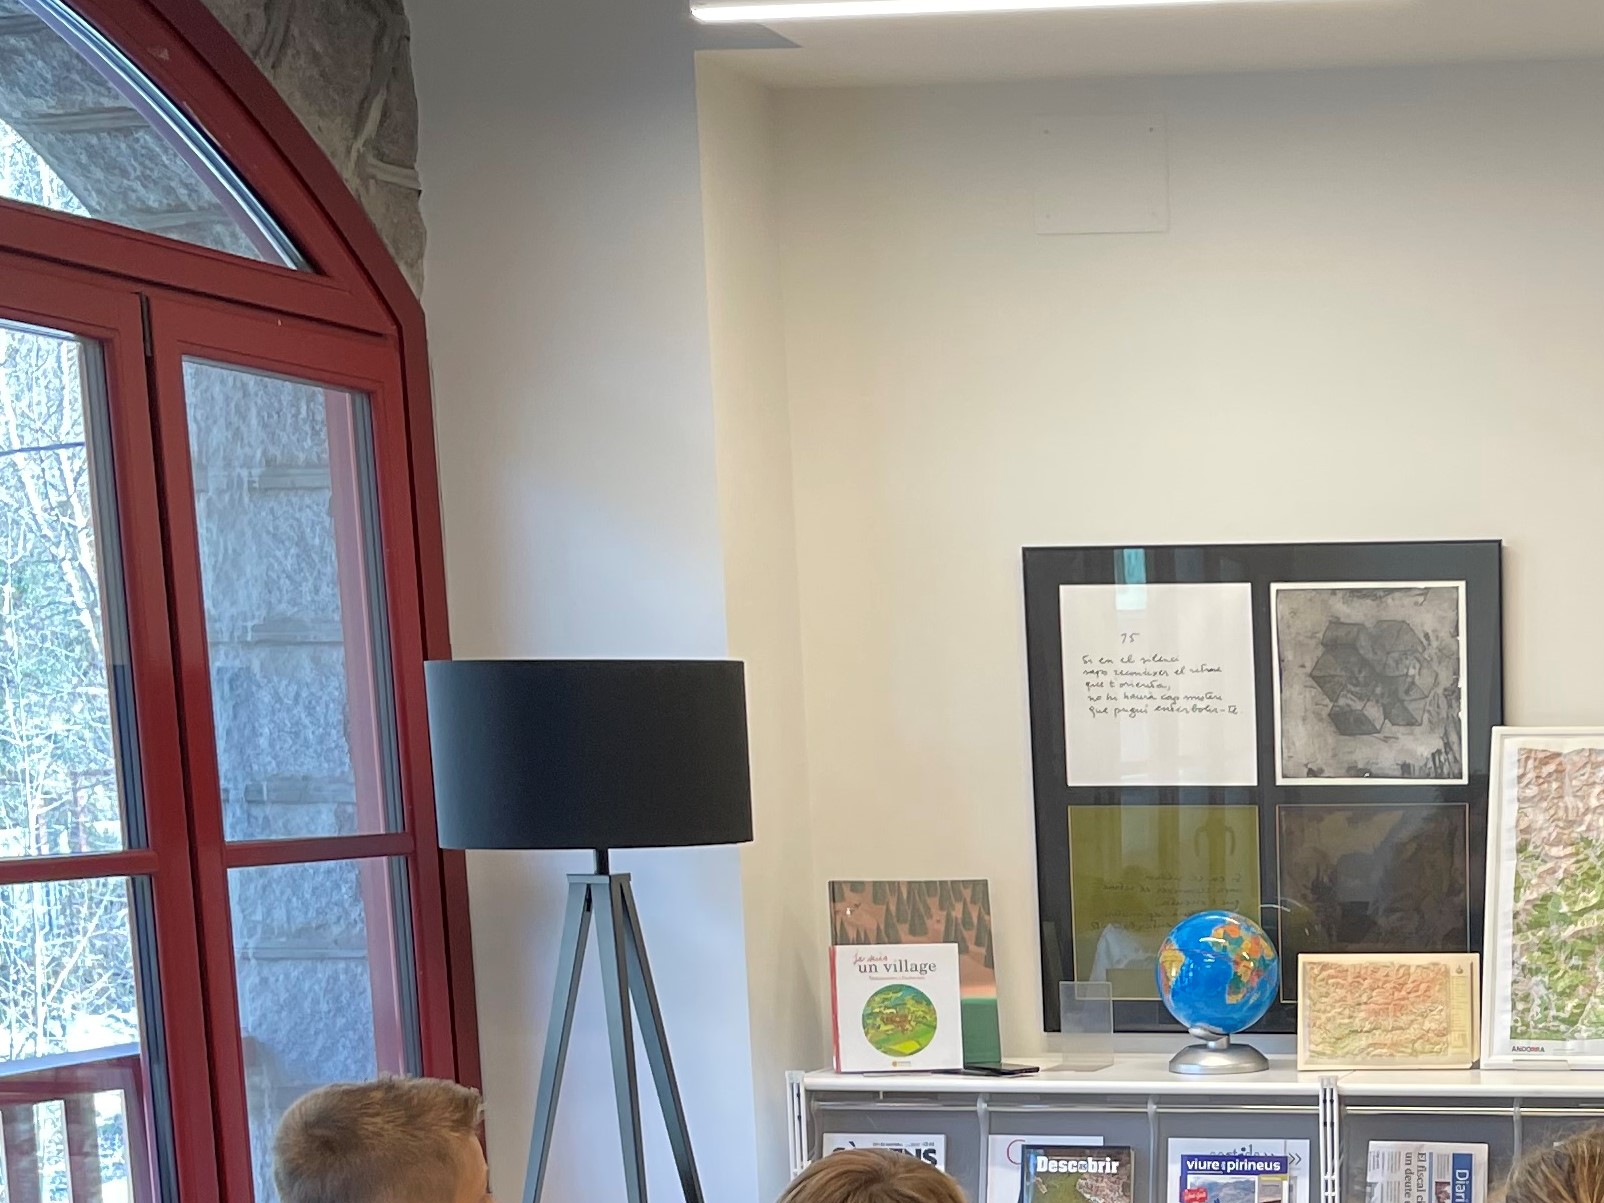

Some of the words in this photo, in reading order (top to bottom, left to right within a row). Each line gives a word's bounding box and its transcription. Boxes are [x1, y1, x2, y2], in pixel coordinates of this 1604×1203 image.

[858, 963, 878, 973] un
[883, 959, 937, 976] village
[1511, 1045, 1546, 1053] ANDORRA
[1036, 1156, 1120, 1173] Descobrir
[1186, 1158, 1220, 1170] viure
[1226, 1159, 1281, 1173] pirineus
[1404, 1152, 1413, 1165] un
[1416, 1152, 1427, 1163] El
[1403, 1168, 1414, 1197] deute
[1416, 1165, 1427, 1192] fiscal
[1455, 1169, 1470, 1202] Diari
